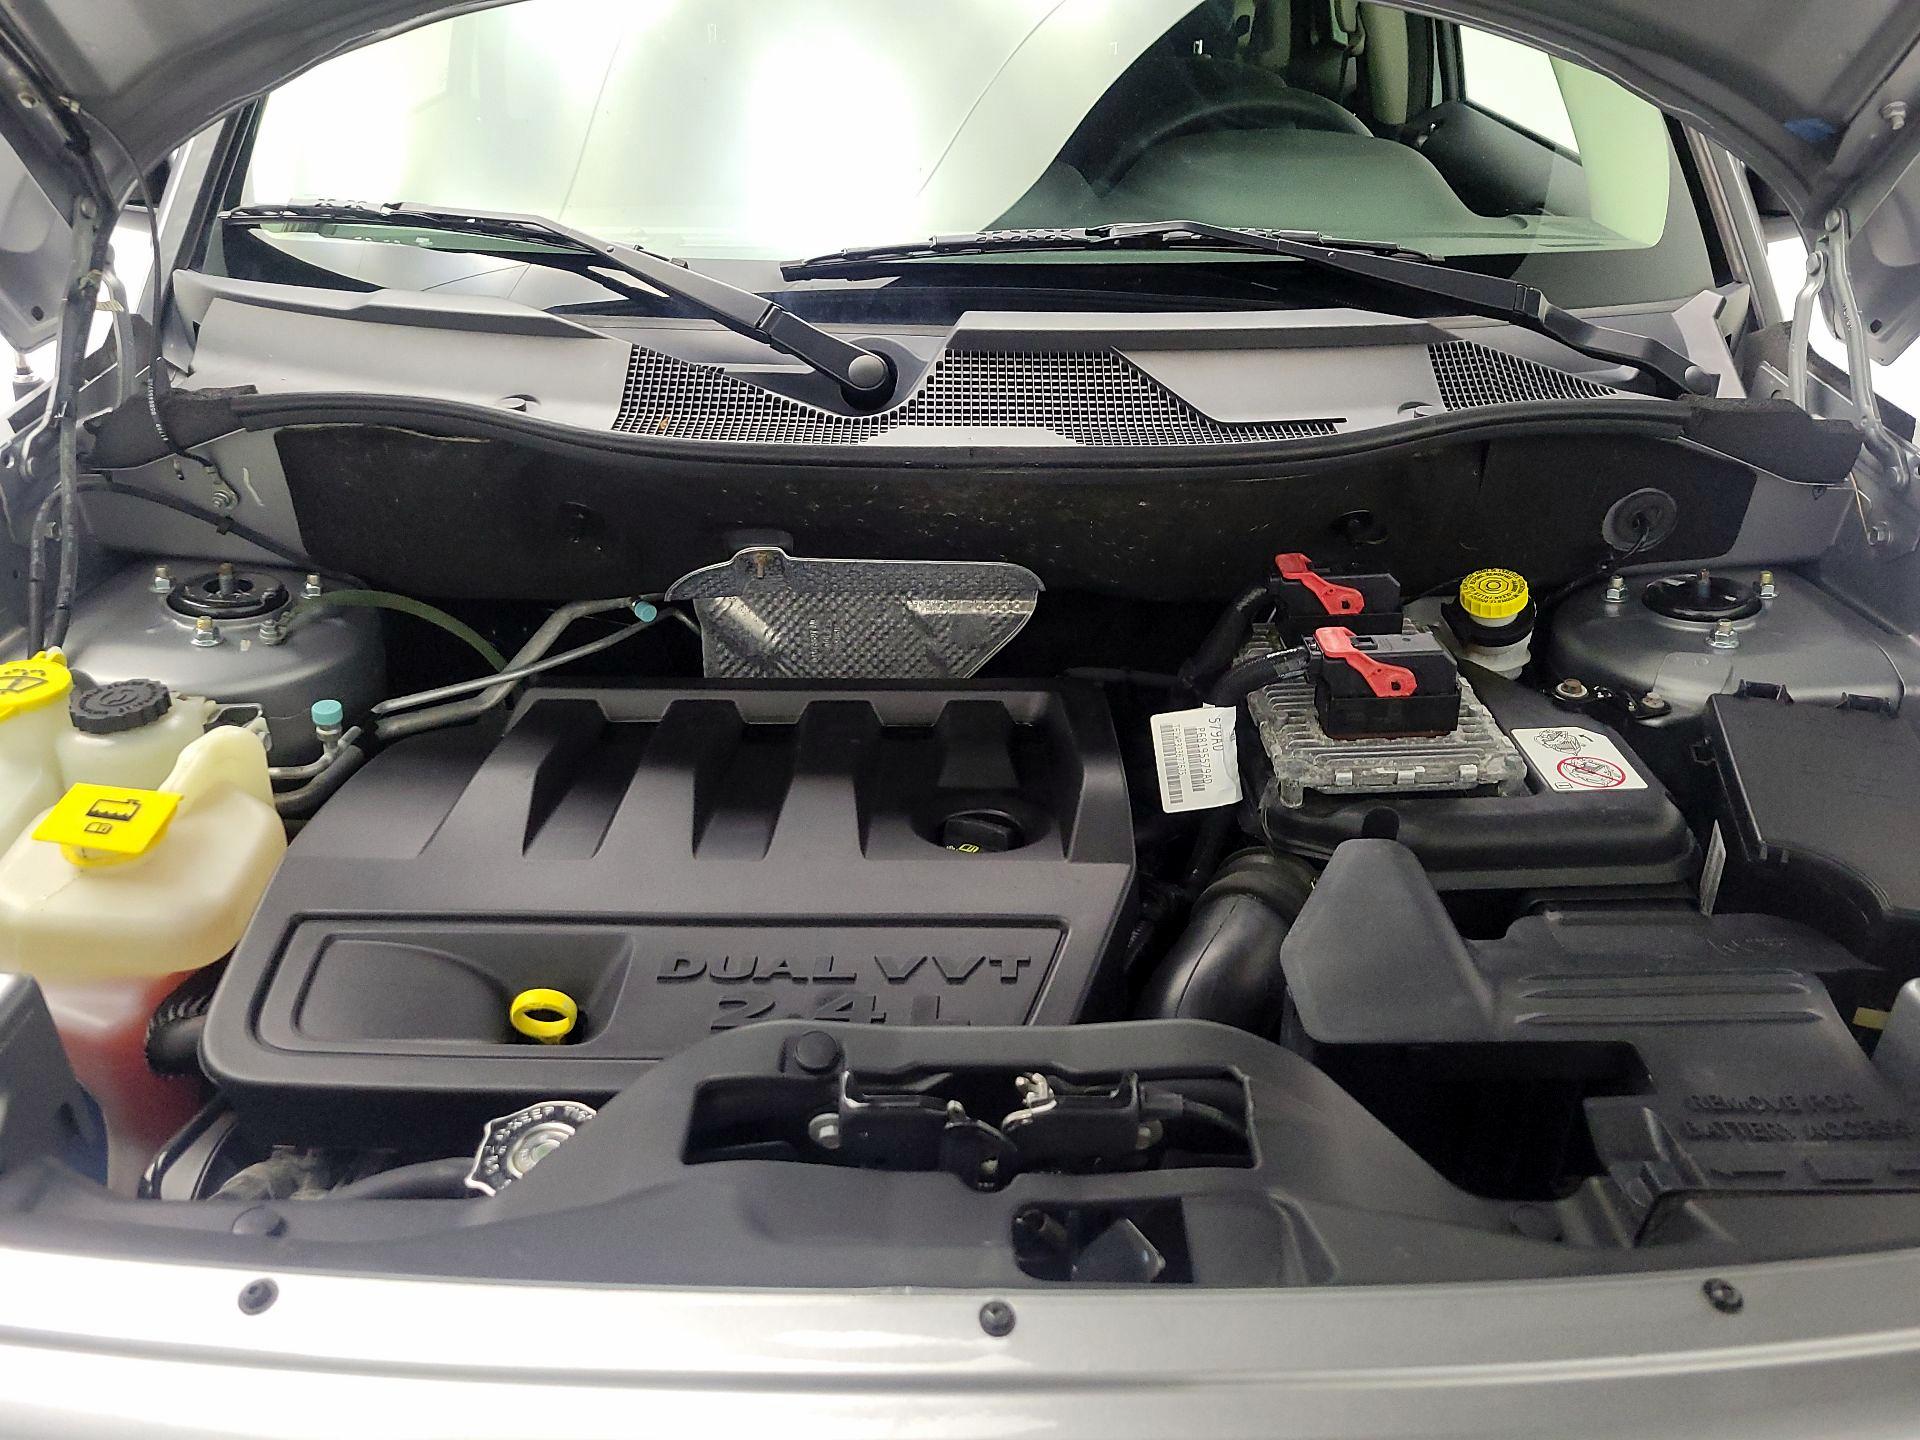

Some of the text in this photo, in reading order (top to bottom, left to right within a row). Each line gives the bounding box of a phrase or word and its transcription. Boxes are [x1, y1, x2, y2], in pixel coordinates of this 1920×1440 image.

[1208, 717, 1224, 752] 579AD
[656, 954, 1032, 985] DUAL VVT
